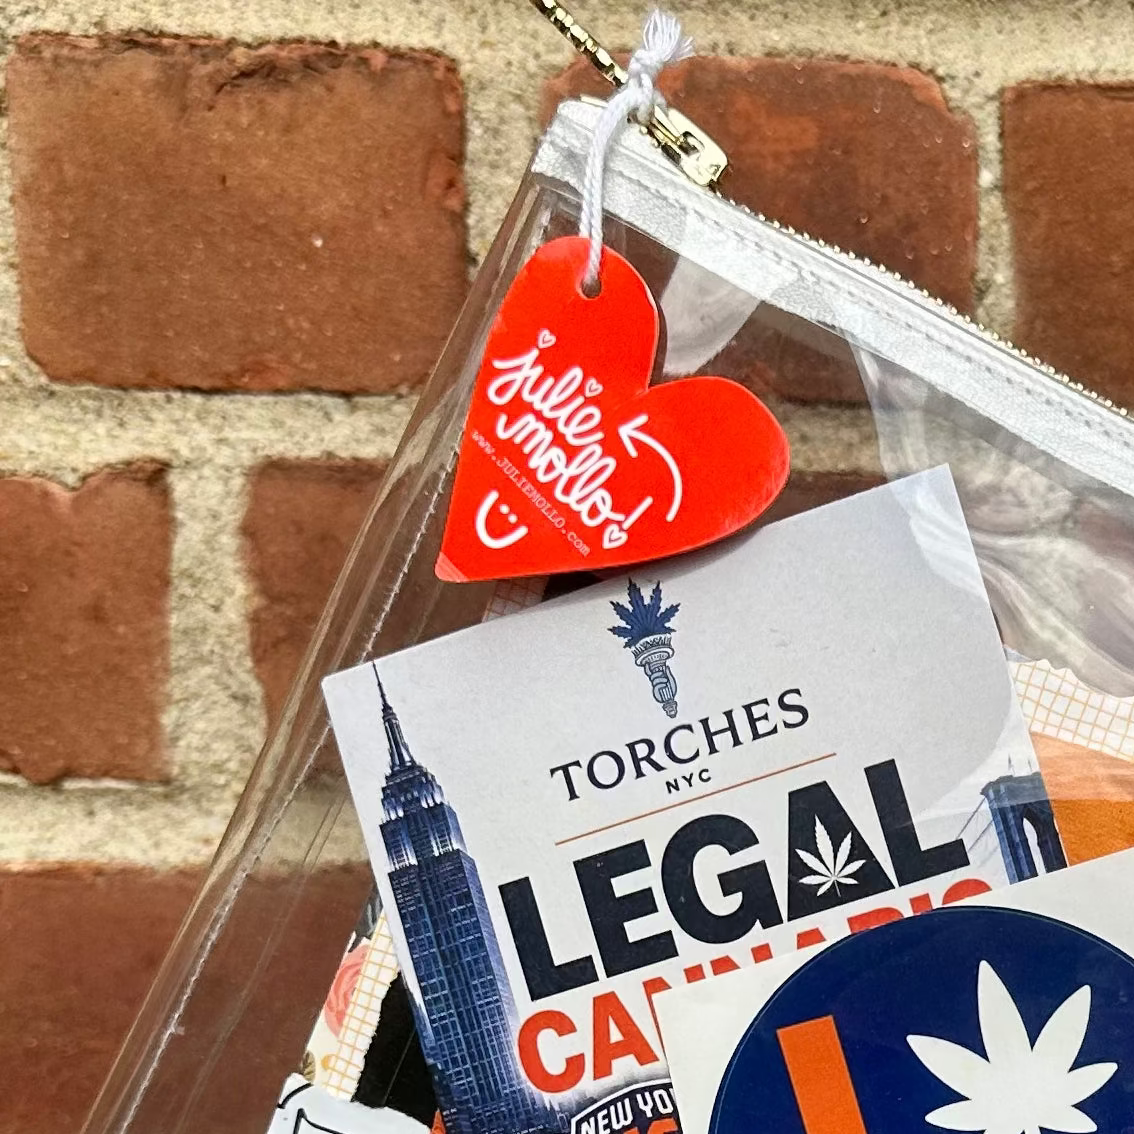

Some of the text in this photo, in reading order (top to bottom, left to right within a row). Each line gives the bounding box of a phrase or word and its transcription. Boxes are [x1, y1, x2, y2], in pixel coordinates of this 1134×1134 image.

[549, 687, 810, 801] TORCHES
[665, 768, 712, 794] NYC
[498, 758, 970, 1001] LEGAL
[637, 1088, 676, 1118] YO
